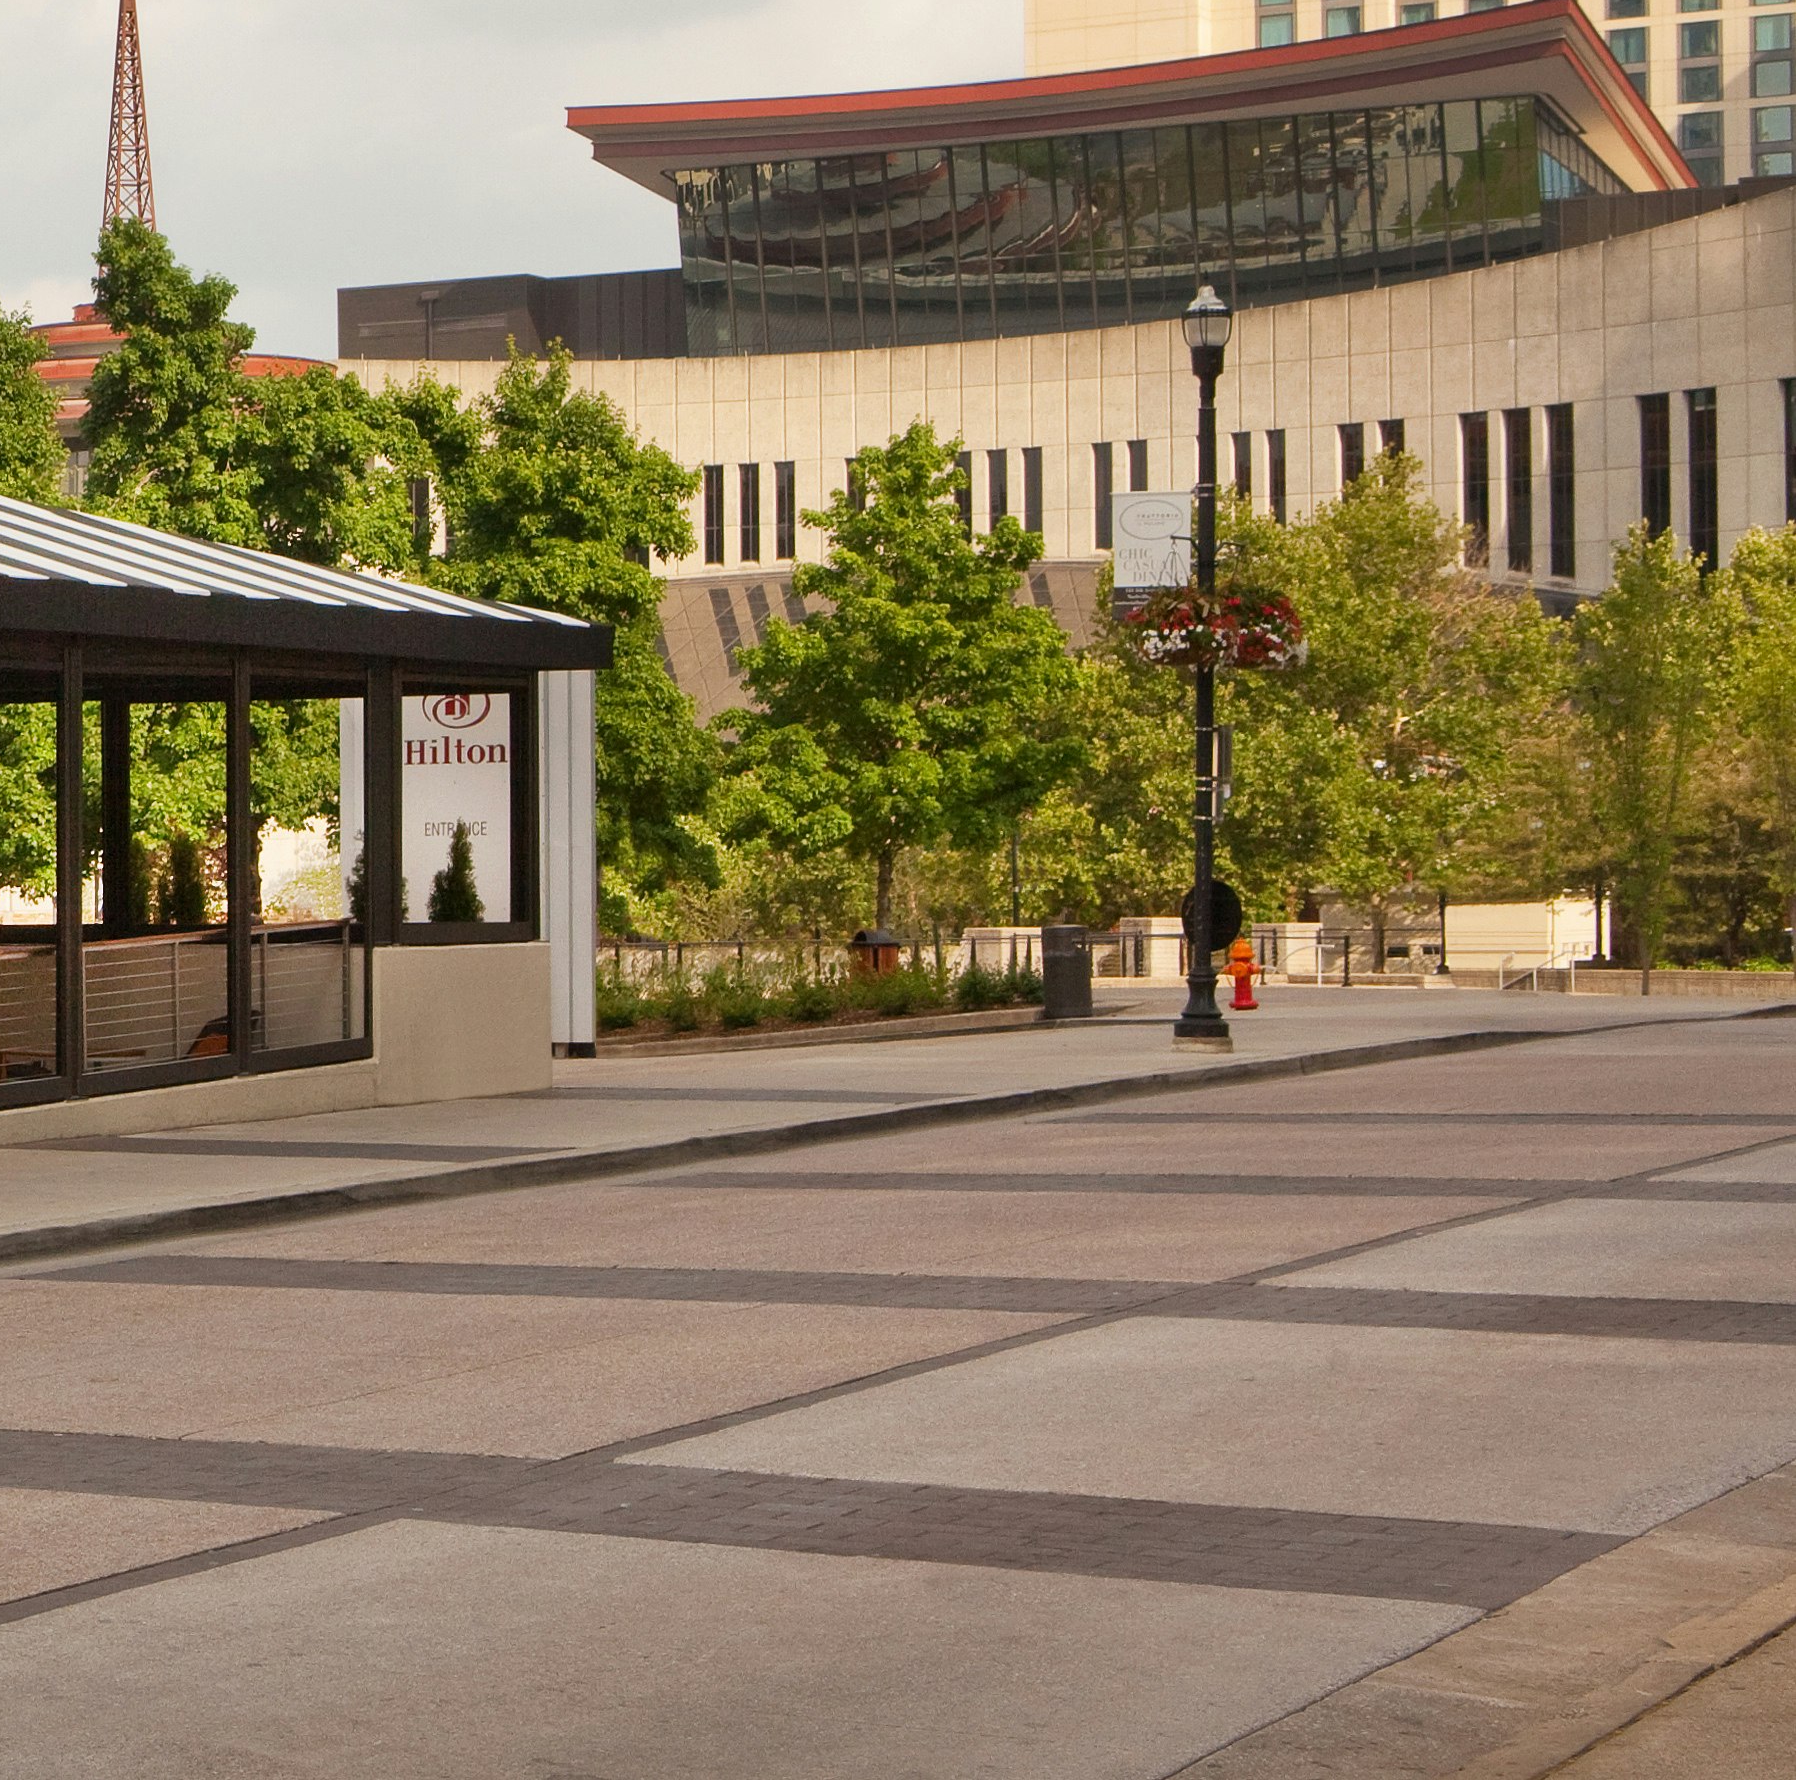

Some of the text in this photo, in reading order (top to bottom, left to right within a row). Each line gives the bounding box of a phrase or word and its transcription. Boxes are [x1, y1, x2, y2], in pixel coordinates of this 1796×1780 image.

[1119, 548, 1153, 560] CHIC
[404, 735, 508, 766] Hilton
[424, 821, 488, 837] ENTRNCE
